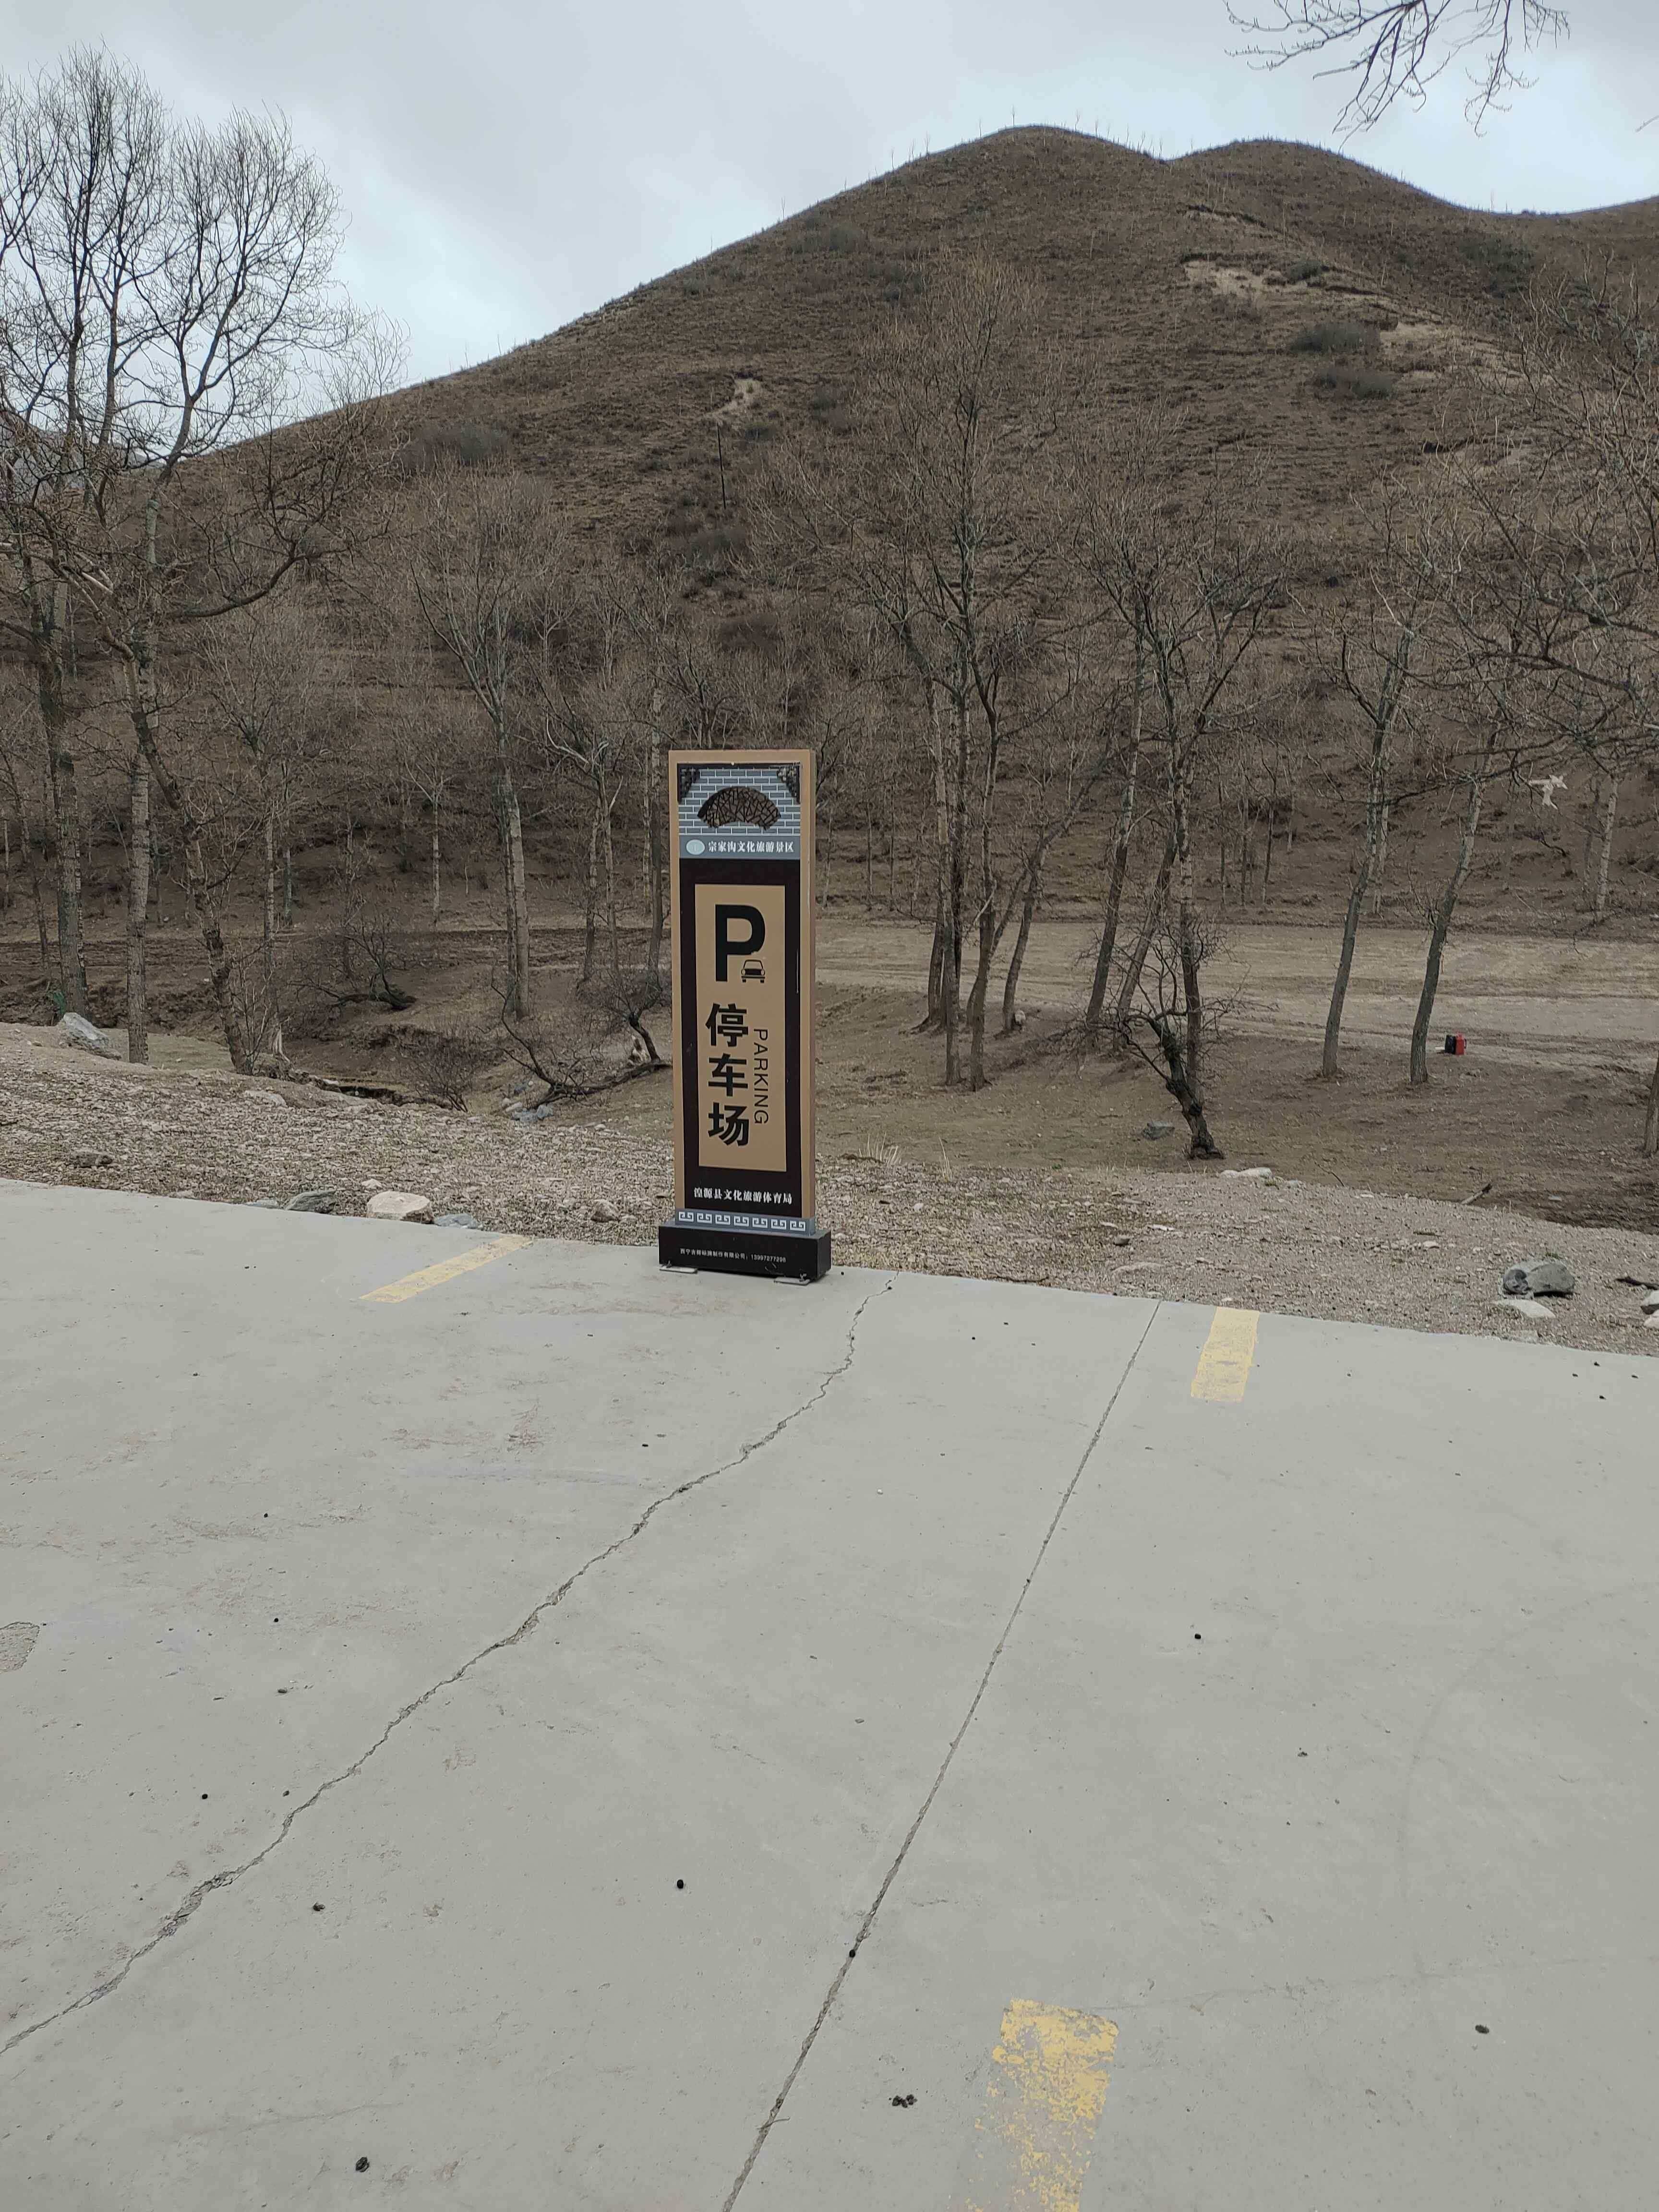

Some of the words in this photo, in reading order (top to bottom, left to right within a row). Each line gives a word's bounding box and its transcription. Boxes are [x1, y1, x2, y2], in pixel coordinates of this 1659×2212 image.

[708, 841, 794, 853] 宗家沟文化旅游景区
[715, 904, 766, 982] P
[705, 1003, 749, 1146] 停车场
[754, 1029, 769, 1124] PARKING
[694, 1187, 792, 1204] 湟源县文化旅游体育局
